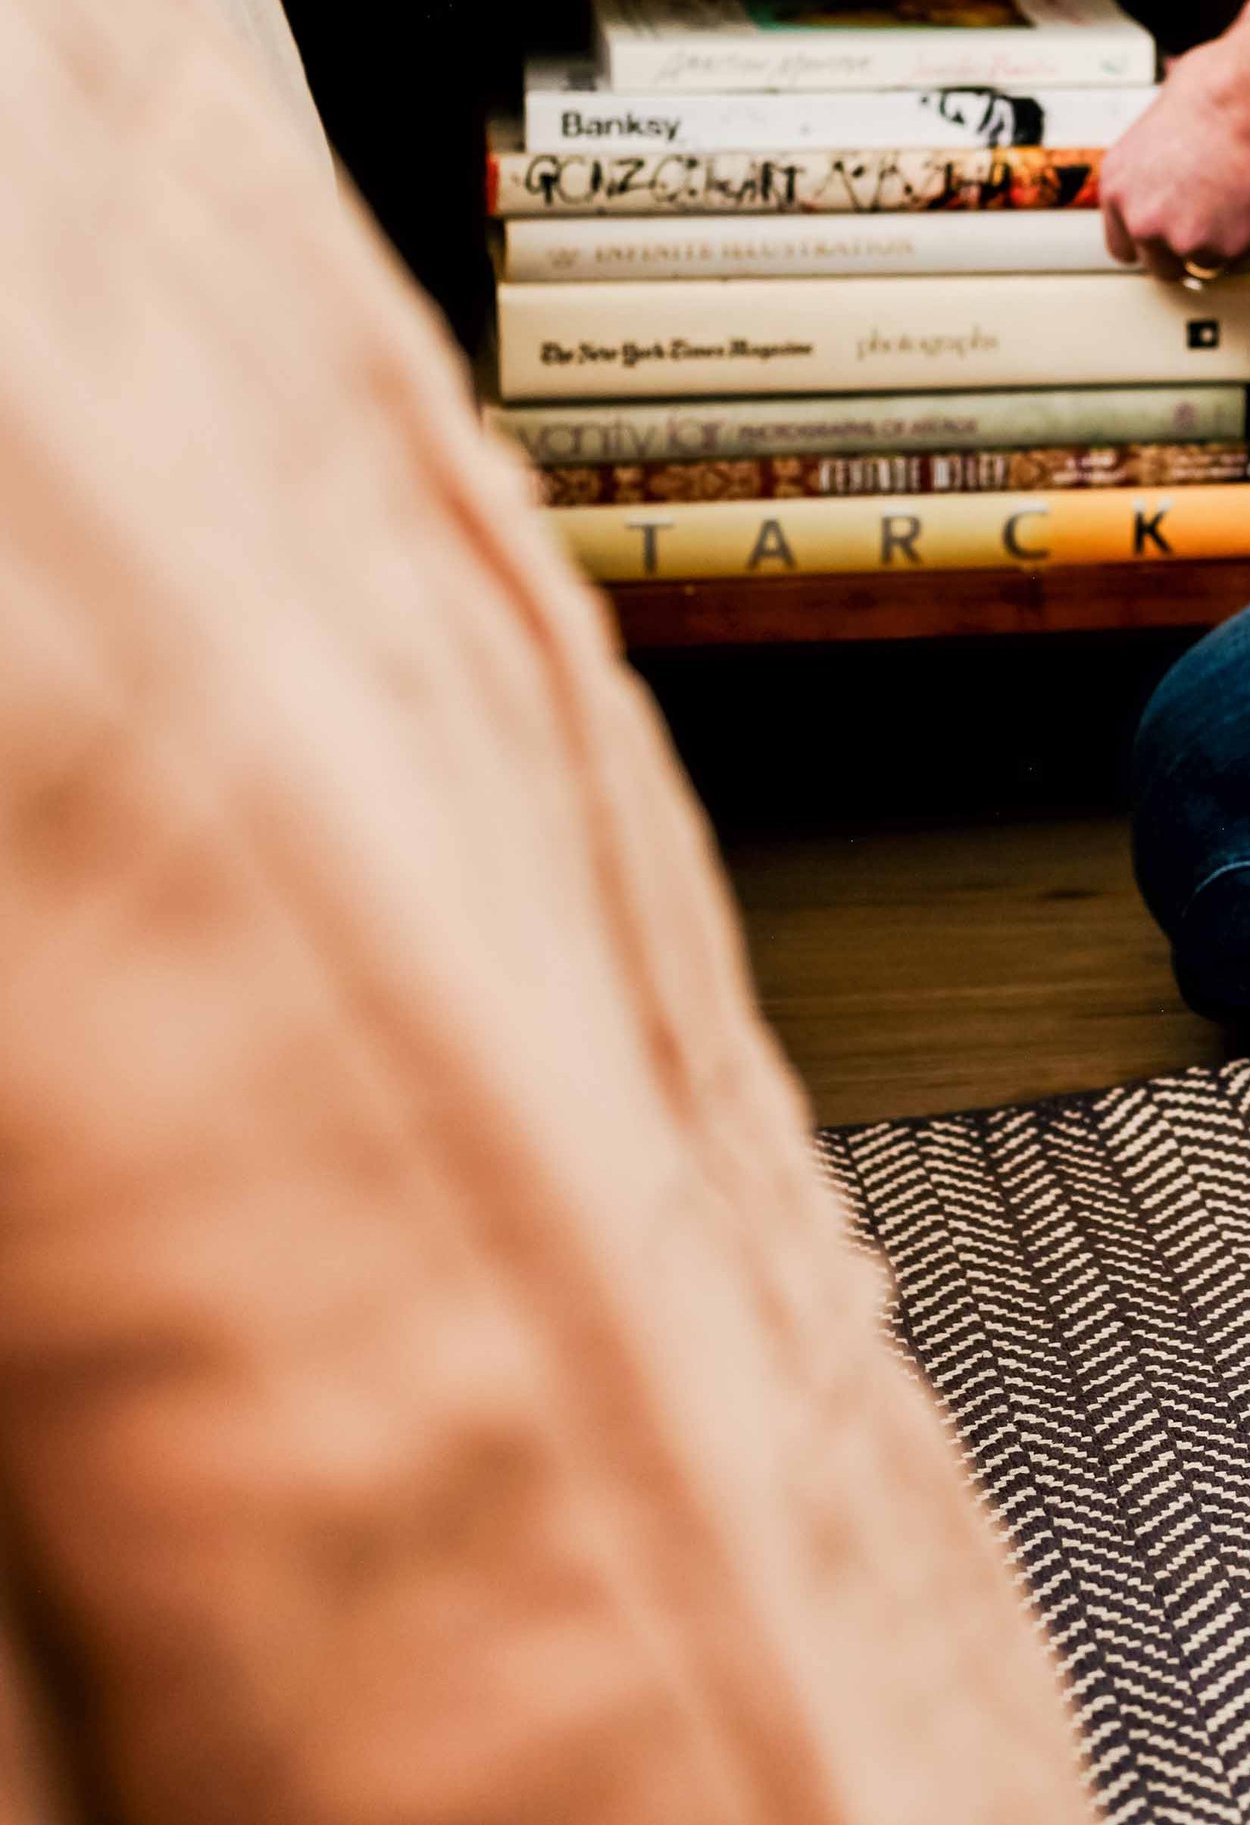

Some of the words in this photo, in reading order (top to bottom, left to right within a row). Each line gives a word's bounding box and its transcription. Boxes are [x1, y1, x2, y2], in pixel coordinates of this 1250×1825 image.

[561, 110, 681, 141] Banksy
[540, 341, 573, 365] The
[577, 340, 617, 365] New
[621, 339, 665, 368] York
[669, 336, 725, 361] Times
[728, 337, 814, 364] Magazine
